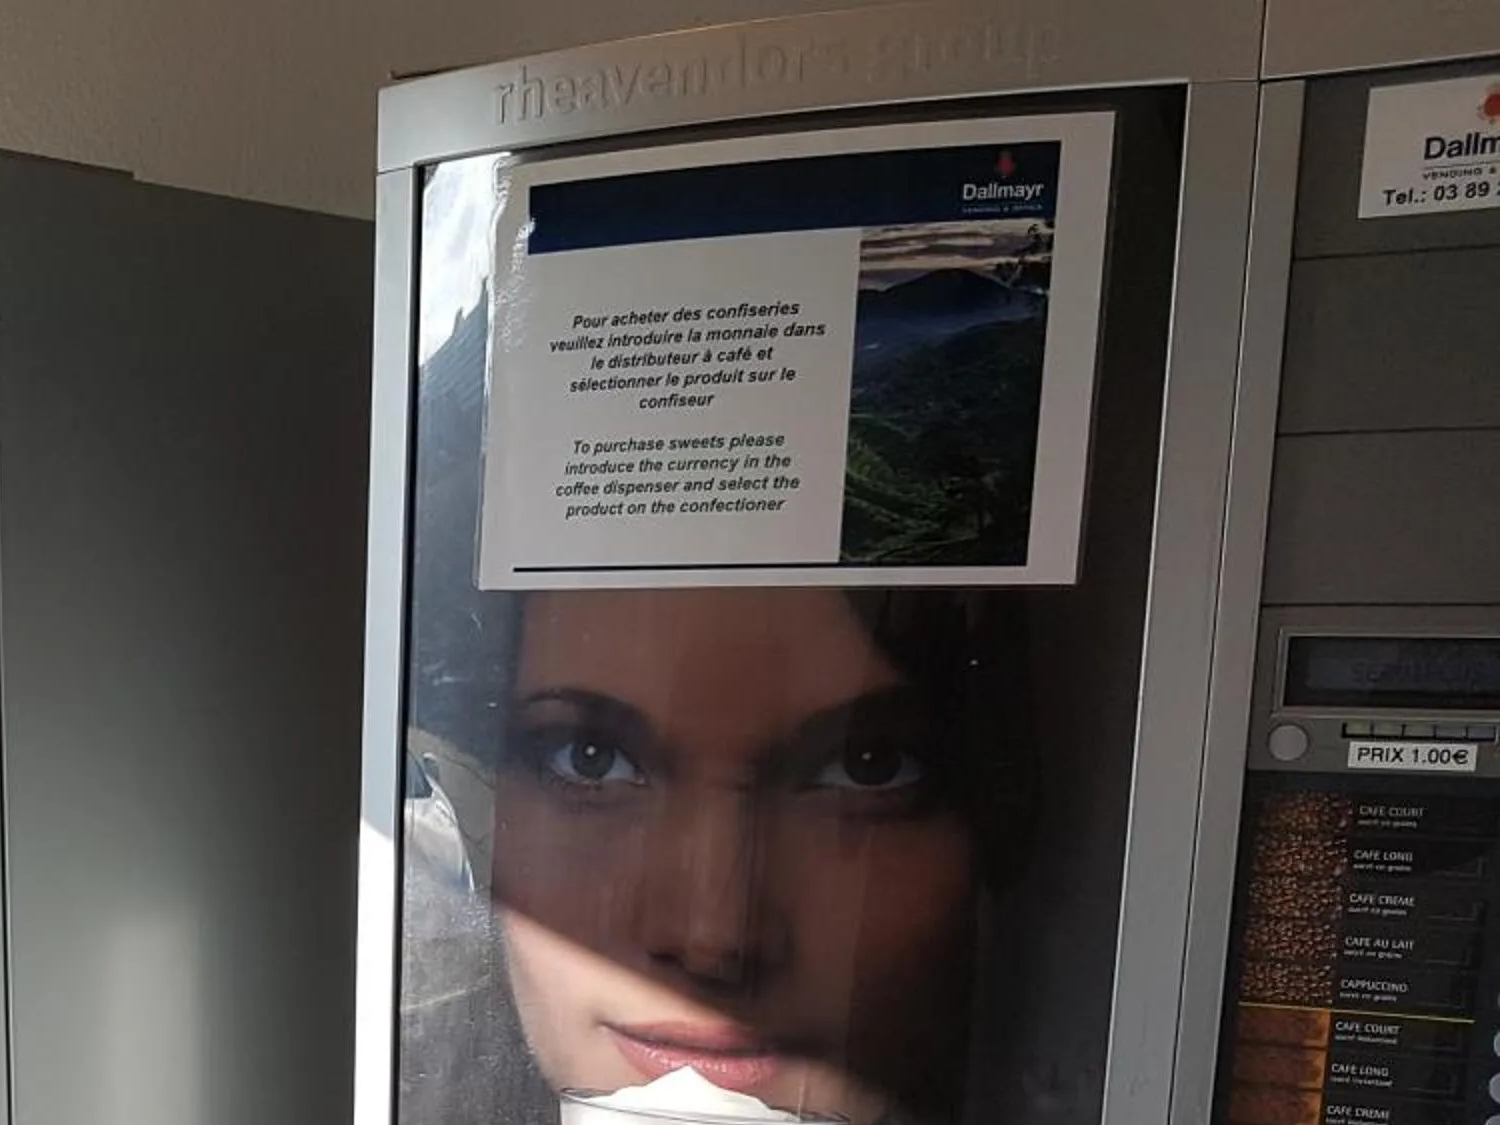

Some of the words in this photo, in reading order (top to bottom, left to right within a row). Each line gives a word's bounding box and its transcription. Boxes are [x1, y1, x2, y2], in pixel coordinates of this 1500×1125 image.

[963, 182, 1045, 201] Dallmayr
[1382, 188, 1427, 206] Tel.:
[1434, 184, 1458, 201] 03
[1465, 181, 1490, 198] 89
[573, 314, 608, 329] Pour
[611, 308, 668, 326] acheter
[673, 307, 701, 322] des
[707, 301, 800, 320] confiseries
[550, 336, 603, 352] veuillez
[607, 330, 683, 348] introduire
[687, 329, 701, 343] la
[705, 325, 778, 342] monnaie
[783, 322, 826, 338] dans
[590, 356, 605, 370] le
[608, 351, 698, 369] distributeur
[702, 348, 712, 363] à
[717, 346, 753, 362] café
[757, 347, 773, 361] et
[570, 374, 662, 393] sélectionner
[665, 372, 680, 387] le
[683, 368, 744, 389] produit
[748, 371, 776, 383] sur
[780, 367, 796, 381] le
[639, 393, 715, 410] confiseur
[573, 440, 591, 455] To
[593, 437, 665, 457] purchase
[668, 436, 725, 450] sweets
[729, 433, 785, 451] please
[565, 460, 635, 476] introduce
[639, 458, 663, 473] the
[667, 456, 740, 474] currency
[743, 455, 759, 469] in
[763, 454, 791, 469] the
[556, 482, 599, 497] coffee
[603, 479, 680, 497] dispenser
[683, 477, 714, 492] and
[717, 476, 768, 491] select
[773, 475, 800, 490] the
[565, 501, 623, 520] product
[627, 502, 646, 515] on
[651, 499, 675, 514] the
[679, 498, 788, 513] confectioner
[1357, 747, 1403, 763] PRIX
[1412, 749, 1469, 765] 1.00€
[1340, 979, 1409, 993] CAPPUCCINO
